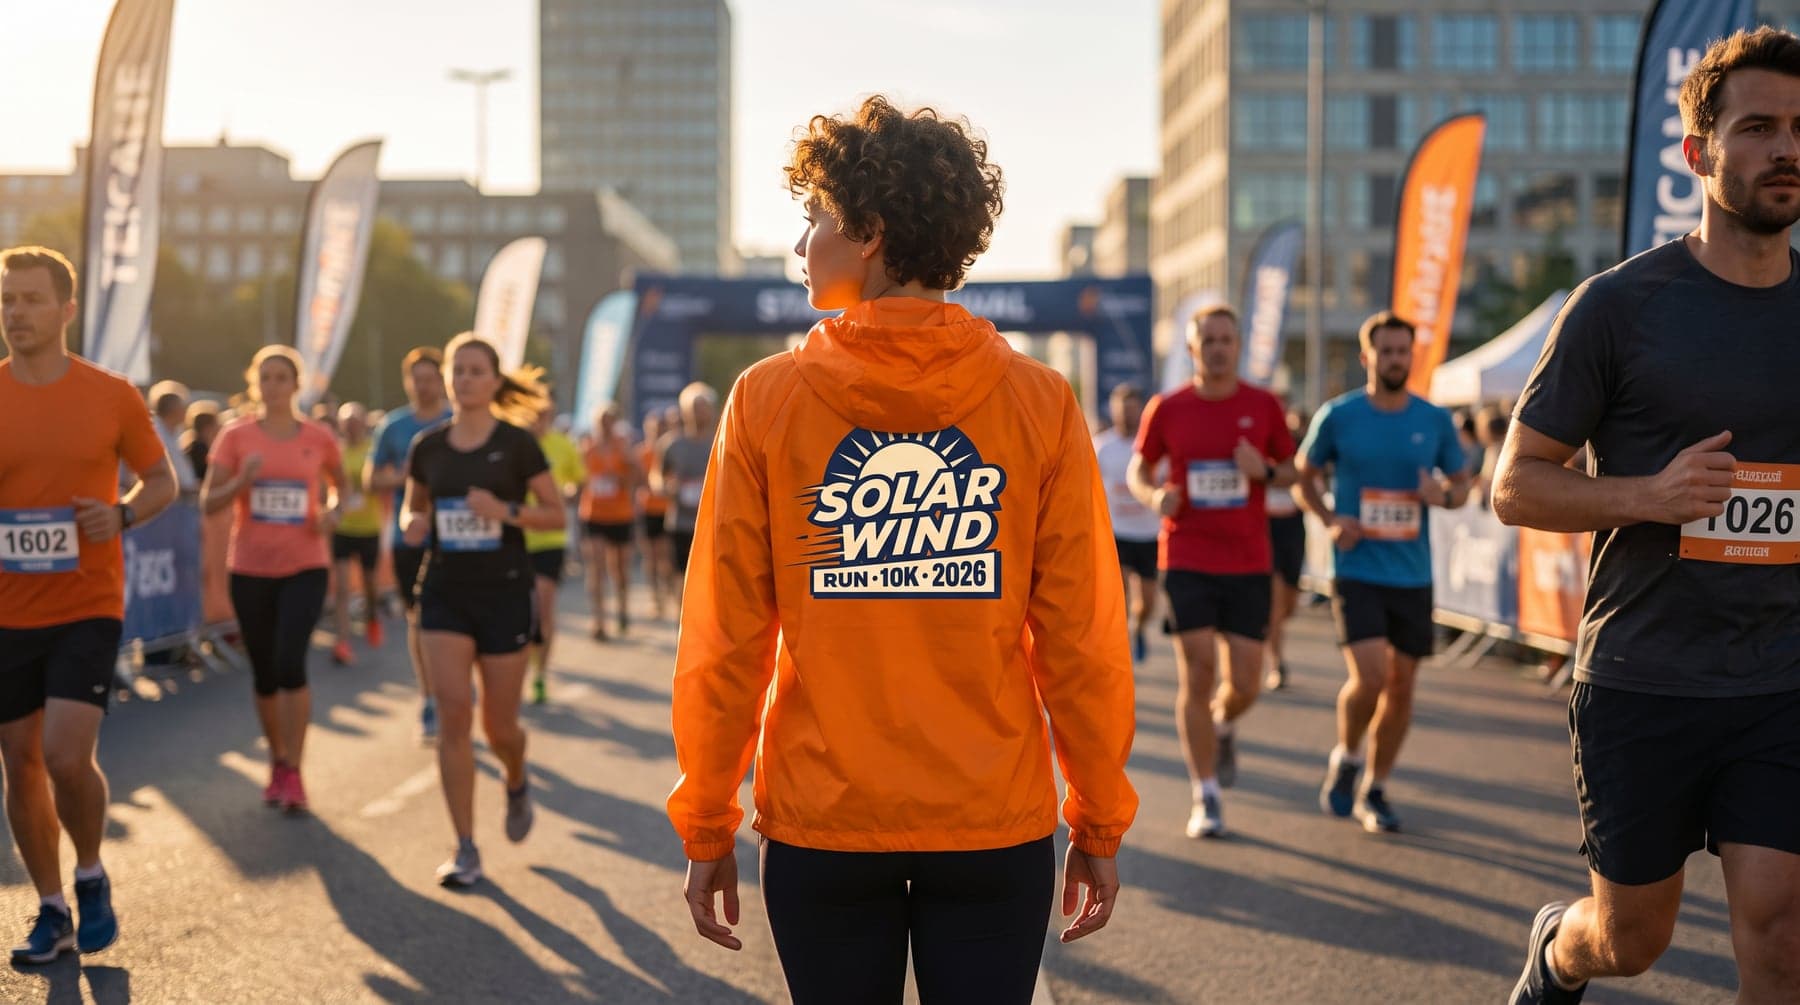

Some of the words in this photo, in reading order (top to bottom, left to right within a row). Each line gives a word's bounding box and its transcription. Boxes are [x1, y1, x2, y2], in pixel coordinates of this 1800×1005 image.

[813, 466, 1001, 522] SOLAR
[5, 528, 68, 553] 1602
[842, 510, 992, 561] WIND
[823, 570, 868, 588] RUN
[880, 565, 919, 587] 10K
[932, 559, 986, 587] 2026
